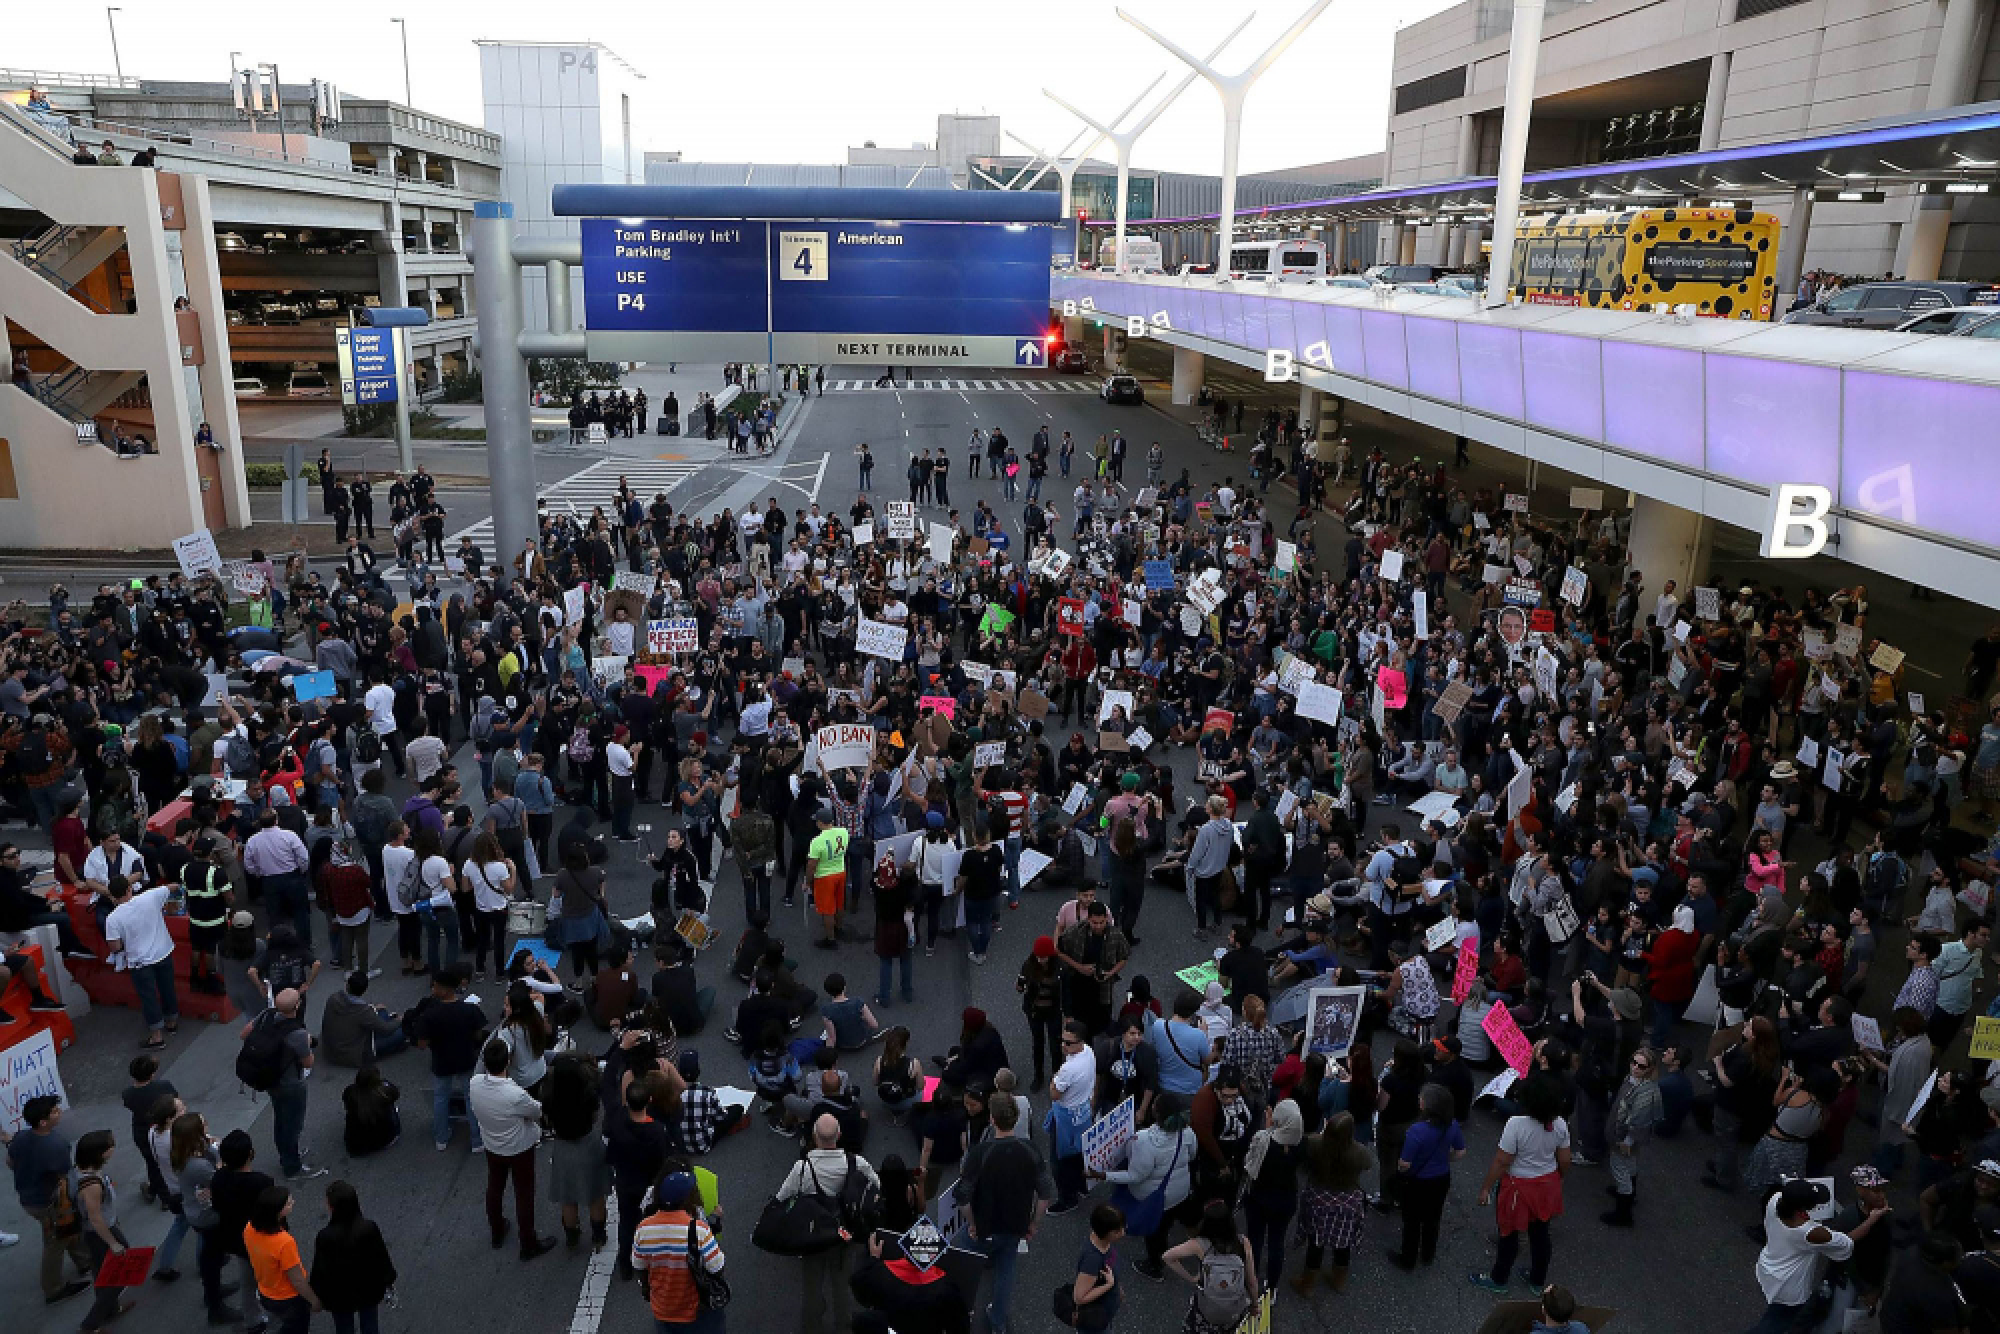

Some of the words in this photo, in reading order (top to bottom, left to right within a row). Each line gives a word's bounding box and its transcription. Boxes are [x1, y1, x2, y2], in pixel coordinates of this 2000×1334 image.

[560, 52, 597, 74] P4
[614, 230, 645, 242] Tom
[651, 230, 705, 244] Bradley
[711, 230, 740, 242] Int'l
[838, 232, 903, 245] American
[615, 245, 671, 260] Parking
[793, 248, 813, 275] 4
[617, 271, 647, 283] USE
[617, 293, 647, 311] P4
[1063, 300, 1077, 316] B
[1127, 315, 1146, 338] B
[837, 344, 879, 355] NEXT
[886, 344, 969, 357] TERMINAL
[1265, 350, 1293, 382] B
[1767, 483, 1832, 558] B
[648, 619, 696, 630] AMERICA
[649, 629, 696, 642] REJECTS
[654, 640, 696, 651] TRUMP
[820, 728, 836, 750] NO
[842, 726, 870, 744] BAN
